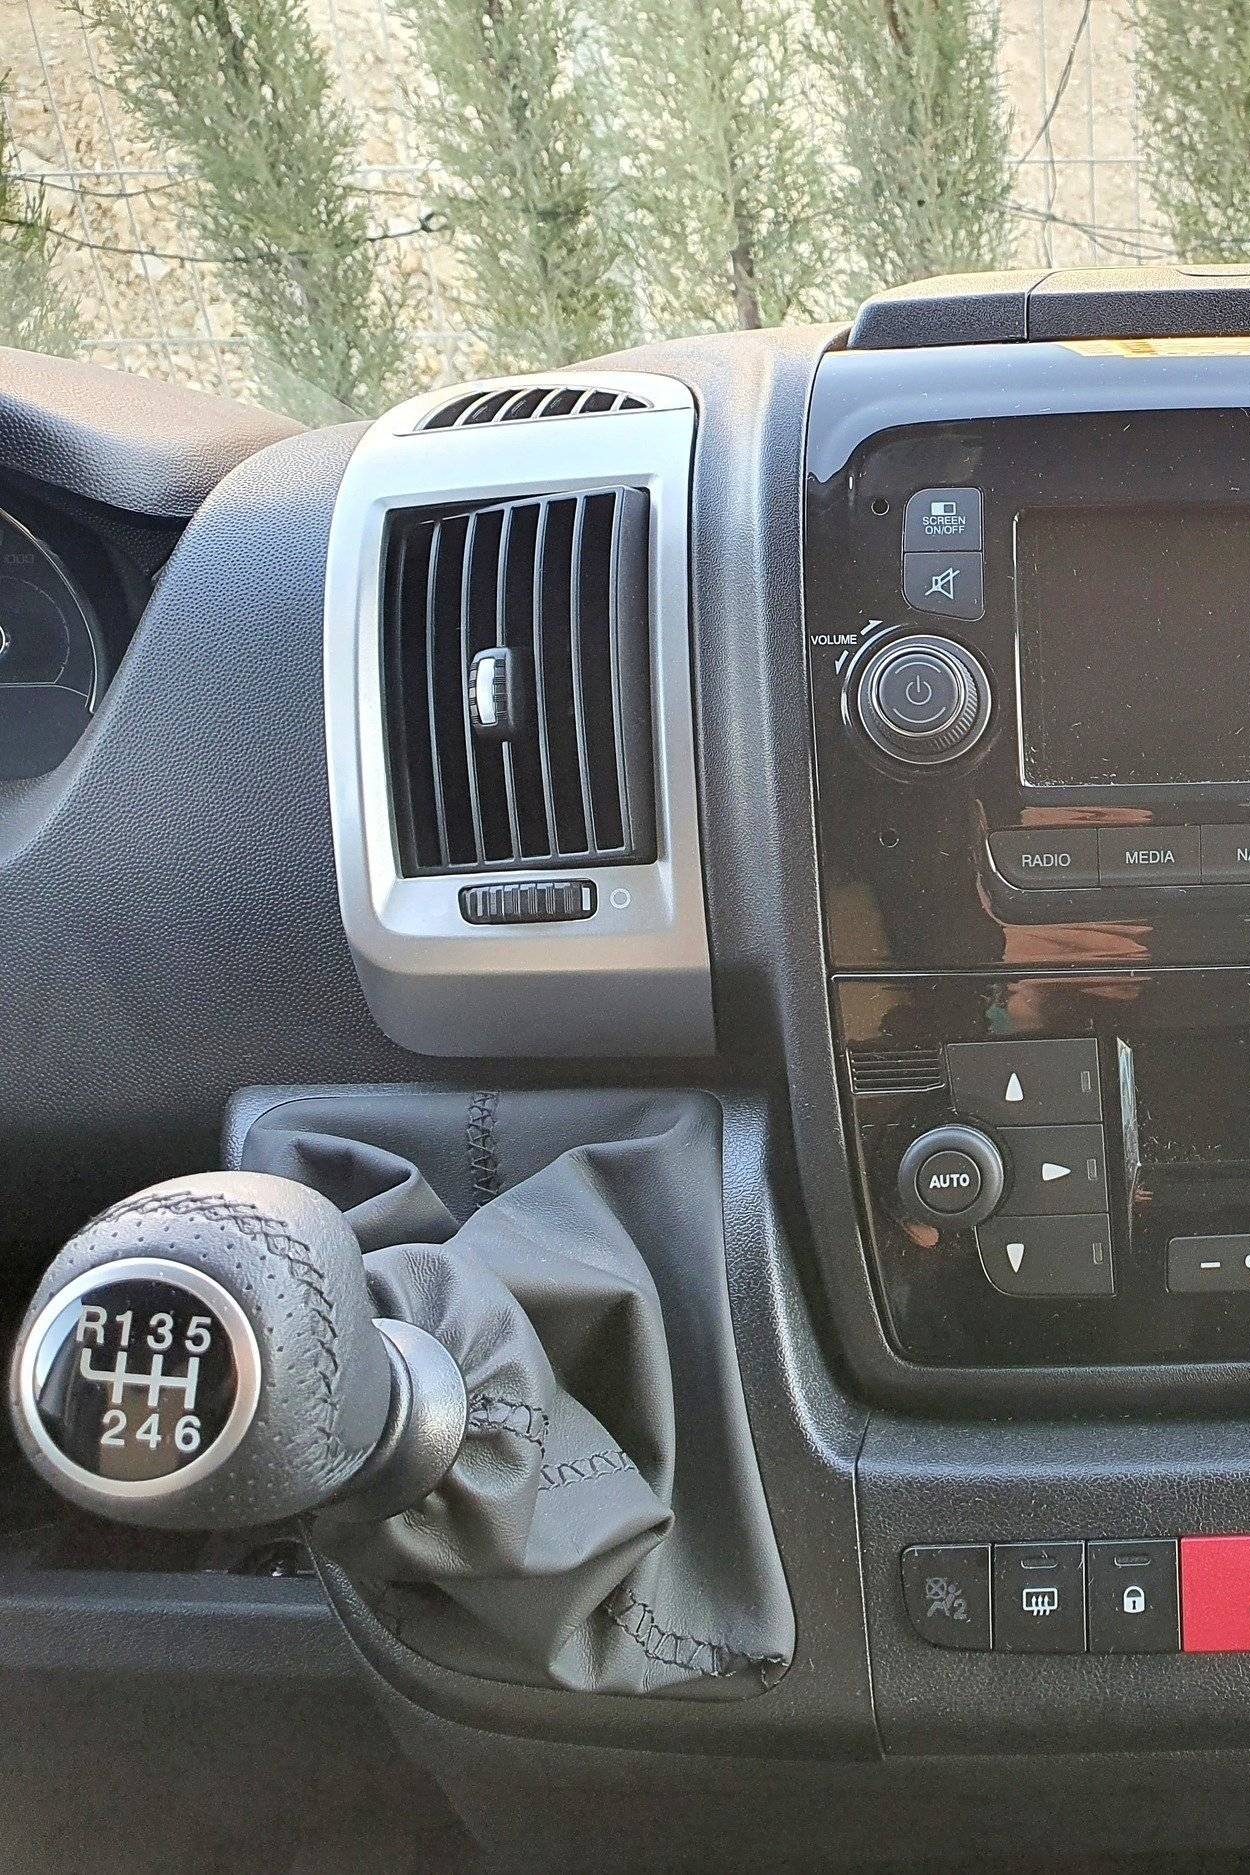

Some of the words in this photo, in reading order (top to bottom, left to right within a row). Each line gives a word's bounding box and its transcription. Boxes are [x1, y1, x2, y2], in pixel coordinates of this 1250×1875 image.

[922, 516, 966, 525] SCREEN
[924, 525, 965, 536] ON/OFF
[810, 634, 858, 645] VOLUME
[1021, 853, 1071, 867] RADIO
[1125, 850, 1175, 864] MEDIA
[928, 1173, 970, 1188] AUTO
